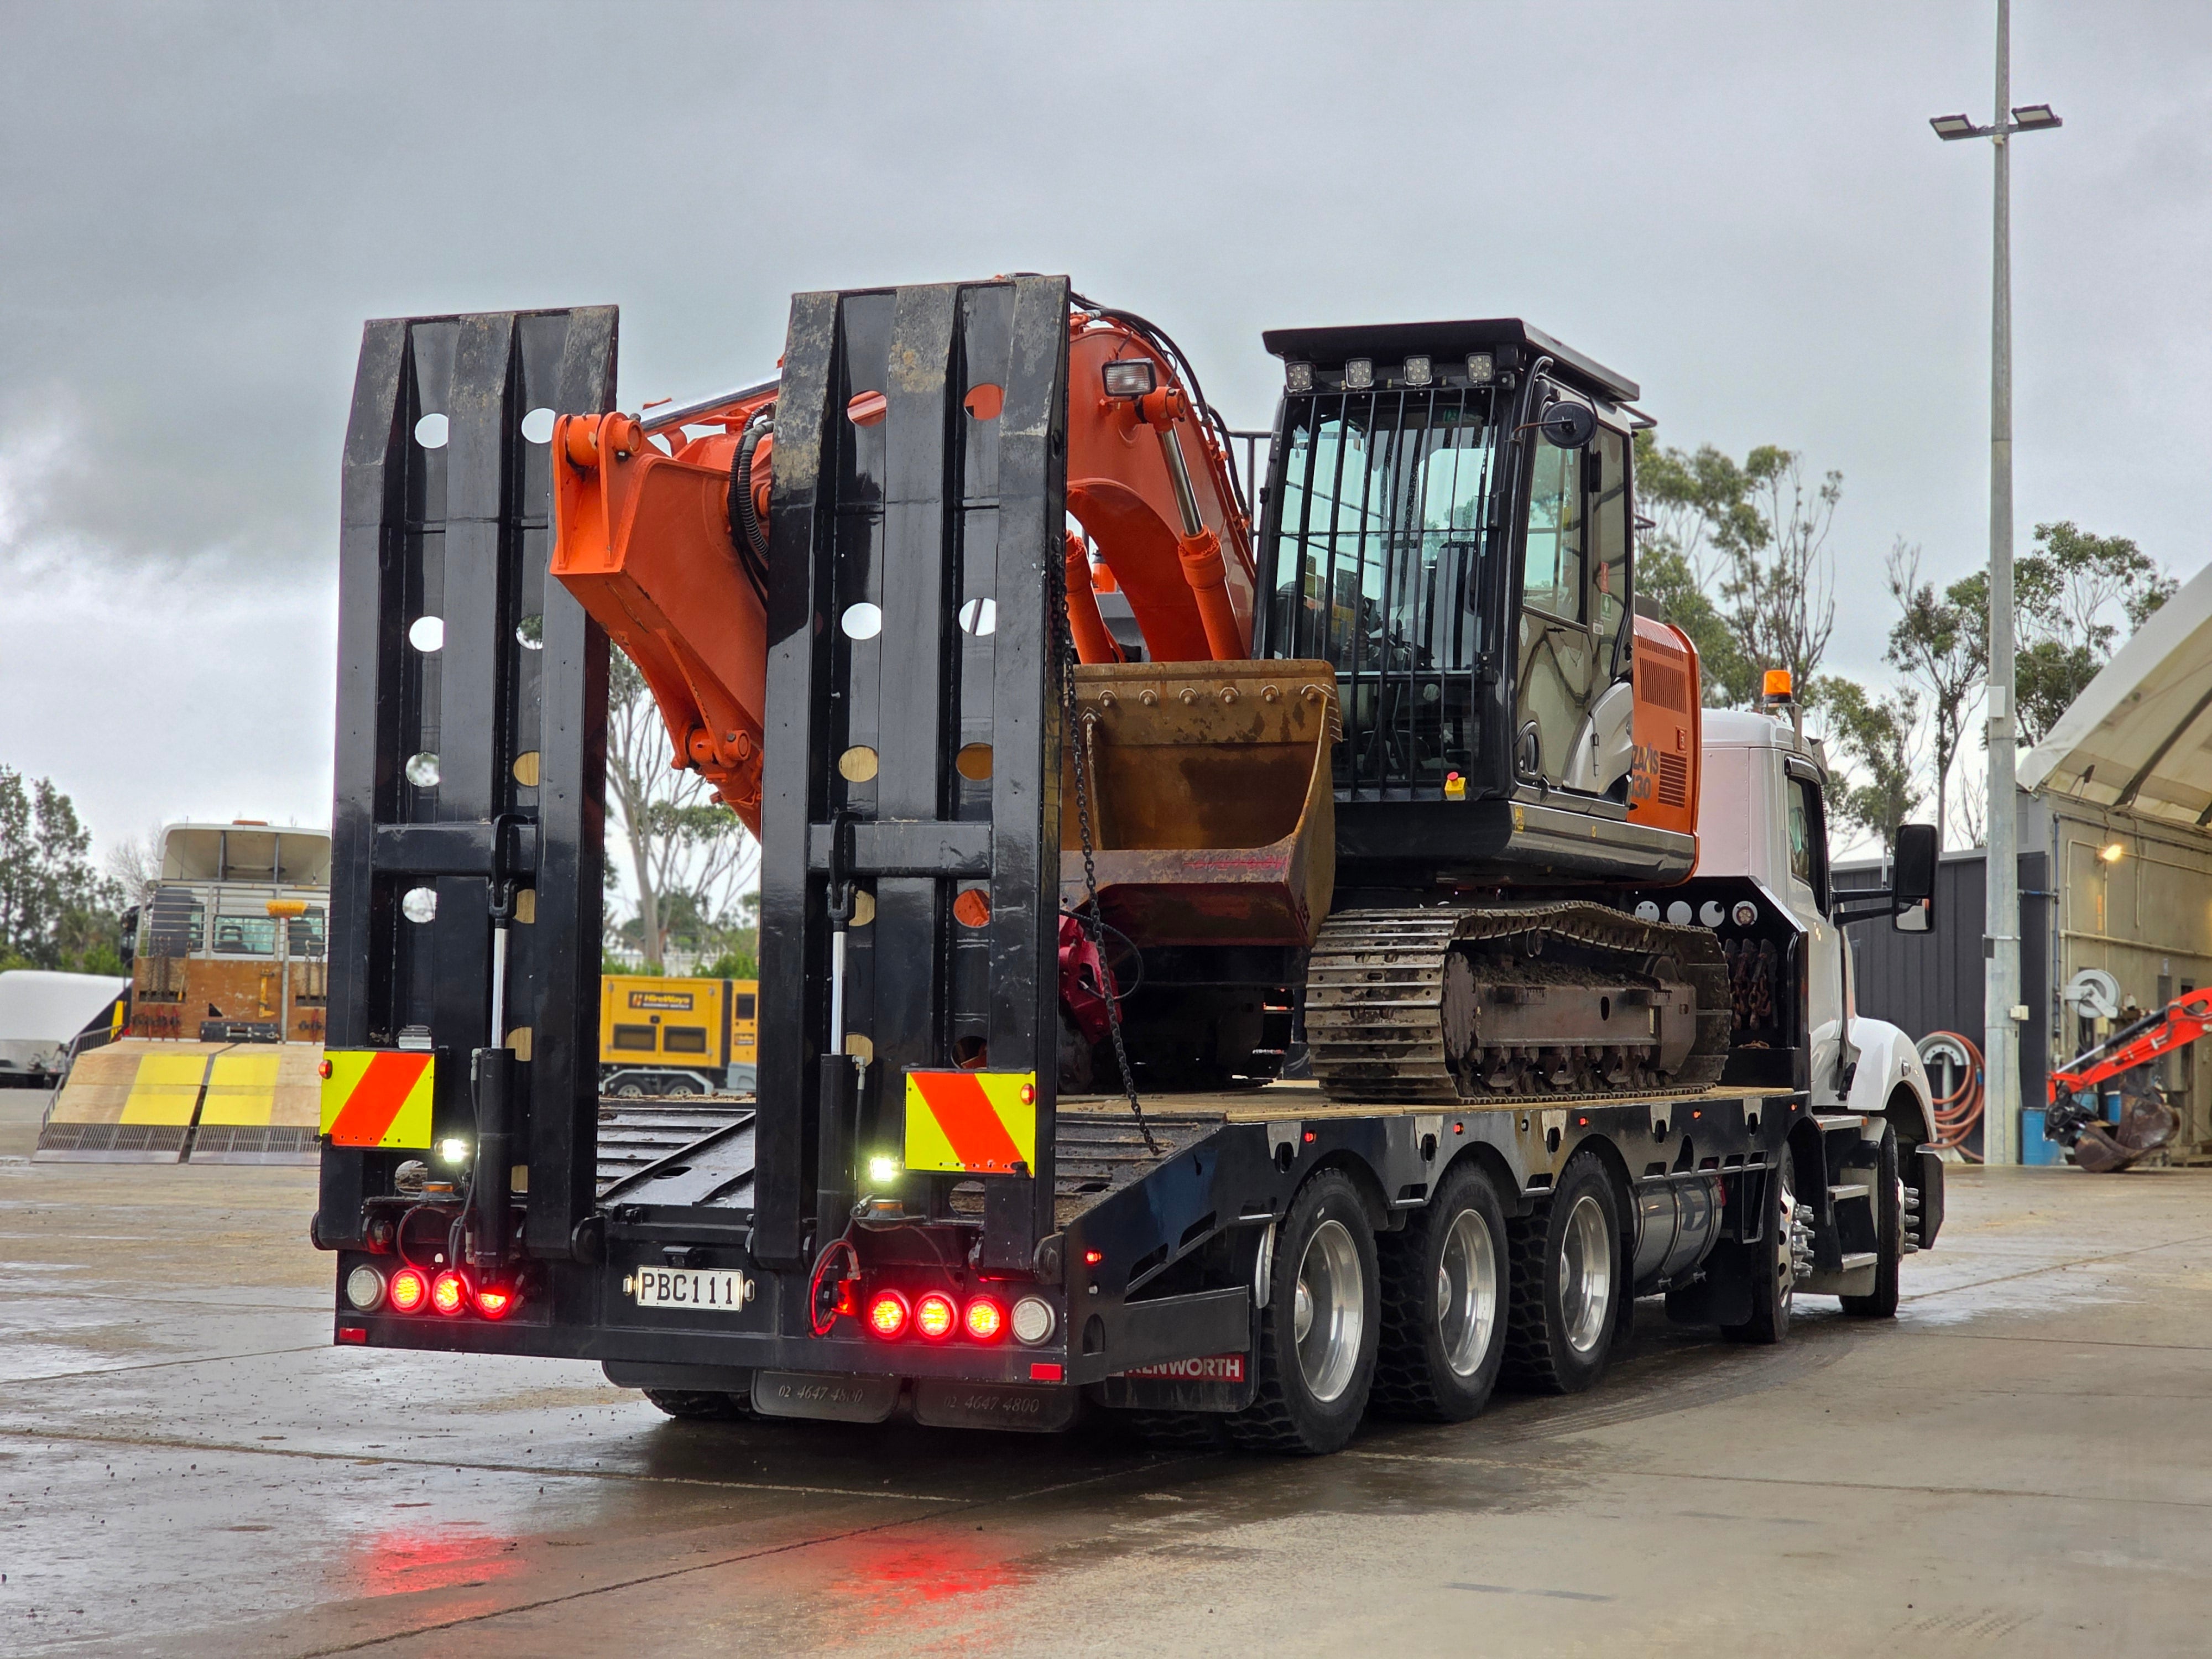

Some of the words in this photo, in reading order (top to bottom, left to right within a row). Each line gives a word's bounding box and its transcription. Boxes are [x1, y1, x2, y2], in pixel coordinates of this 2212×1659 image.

[1632, 743, 1658, 775] ZAXIS
[641, 1272, 733, 1305] PBC111
[1128, 1358, 1239, 1377] NWORTH
[778, 1385, 791, 1397] 02
[797, 1385, 829, 1400] 4647
[943, 1396, 957, 1408] 02
[964, 1395, 1000, 1410] 4647
[1003, 1397, 1040, 1412] 4800
